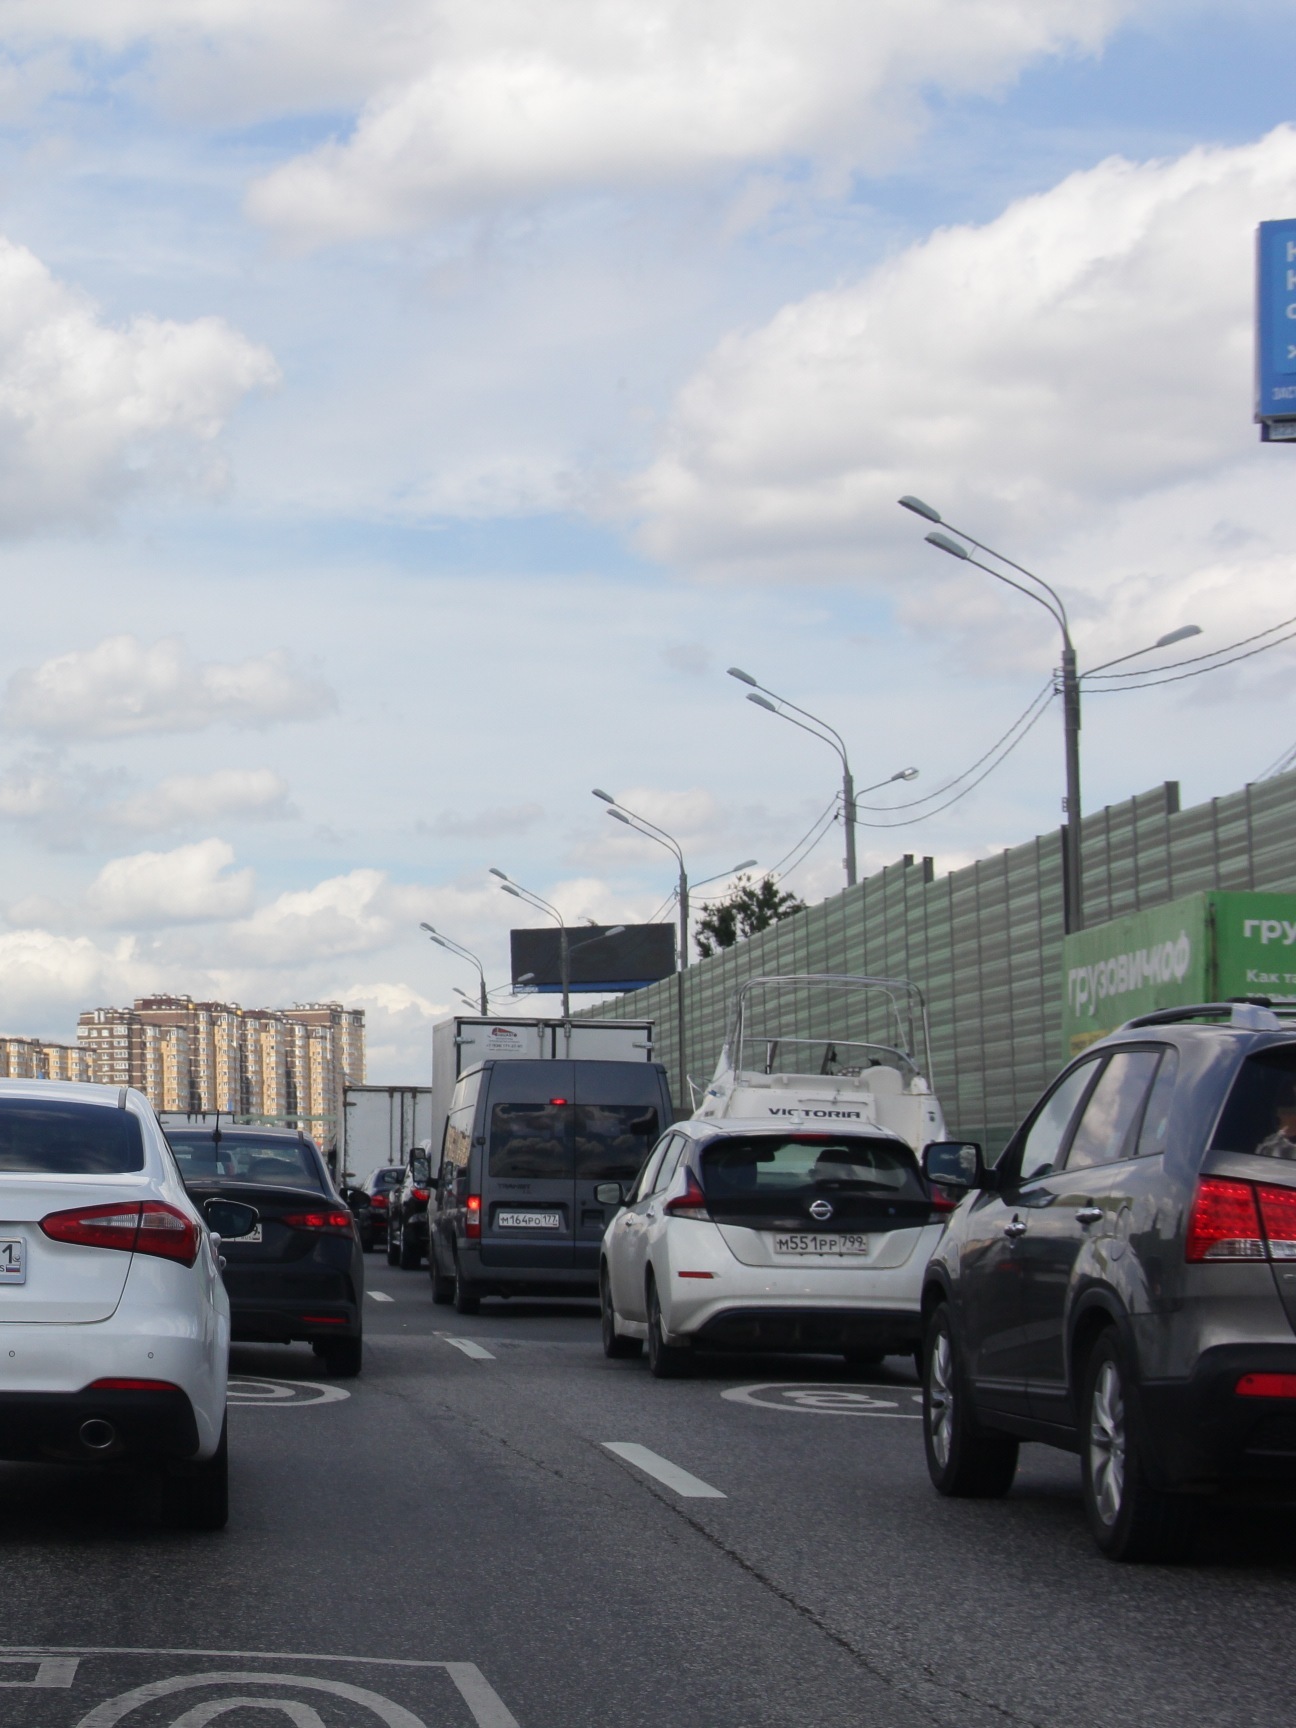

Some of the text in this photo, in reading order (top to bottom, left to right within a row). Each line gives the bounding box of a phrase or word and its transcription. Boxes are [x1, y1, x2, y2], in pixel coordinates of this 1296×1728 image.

[1246, 968, 1280, 983] Как
[768, 1107, 861, 1119] VICTORIA
[840, 1235, 864, 1247] 799
